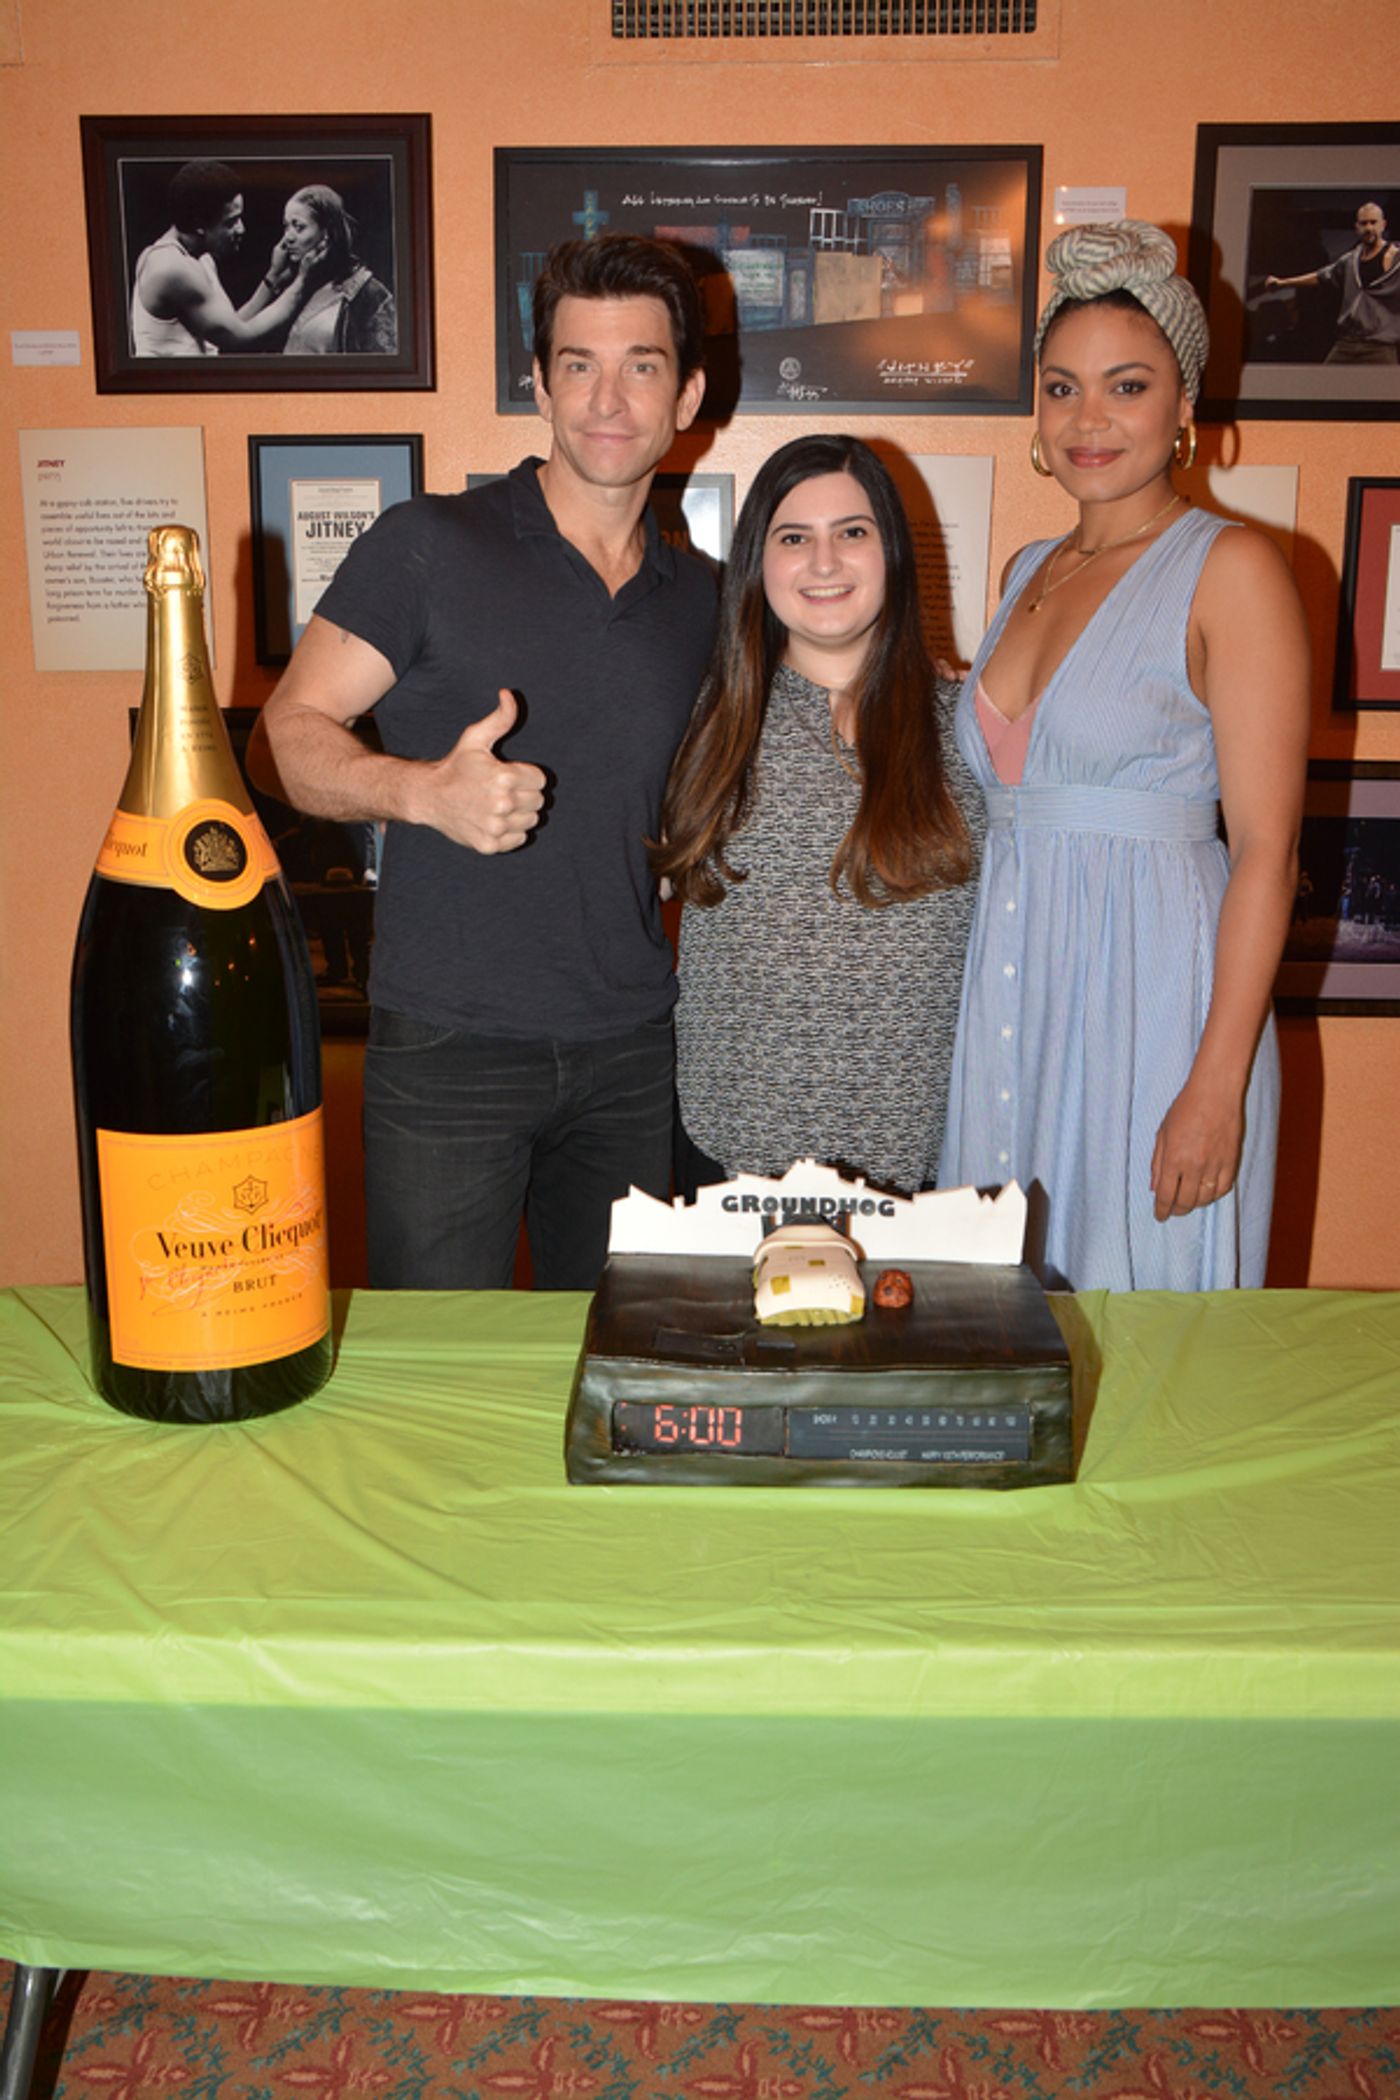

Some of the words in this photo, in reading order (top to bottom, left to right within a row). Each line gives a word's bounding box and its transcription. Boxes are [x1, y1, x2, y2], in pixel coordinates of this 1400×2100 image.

[305, 521, 366, 539] JITNEY
[721, 1194, 896, 1217] GROUNDHOG
[156, 1231, 234, 1260] Veuve
[242, 1208, 323, 1251] Clicquot
[233, 1274, 278, 1293] BRUT
[654, 1404, 742, 1446] 6:00
